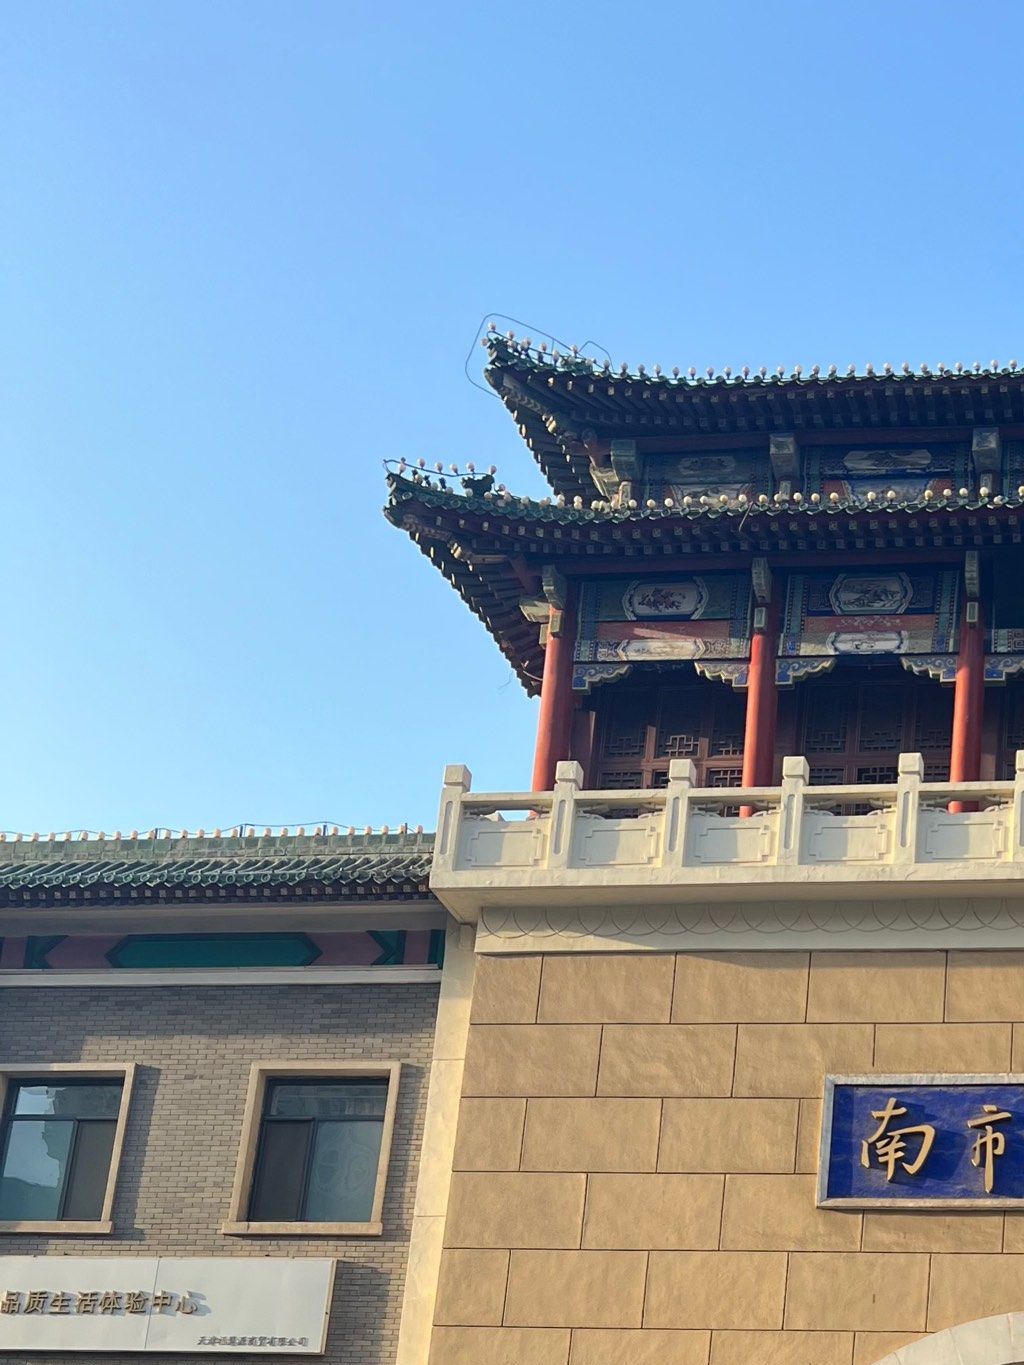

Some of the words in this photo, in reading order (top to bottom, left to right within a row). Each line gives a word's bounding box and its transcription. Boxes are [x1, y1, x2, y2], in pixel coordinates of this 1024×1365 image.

[0, 1289, 199, 1315] 品质生活体验中心
